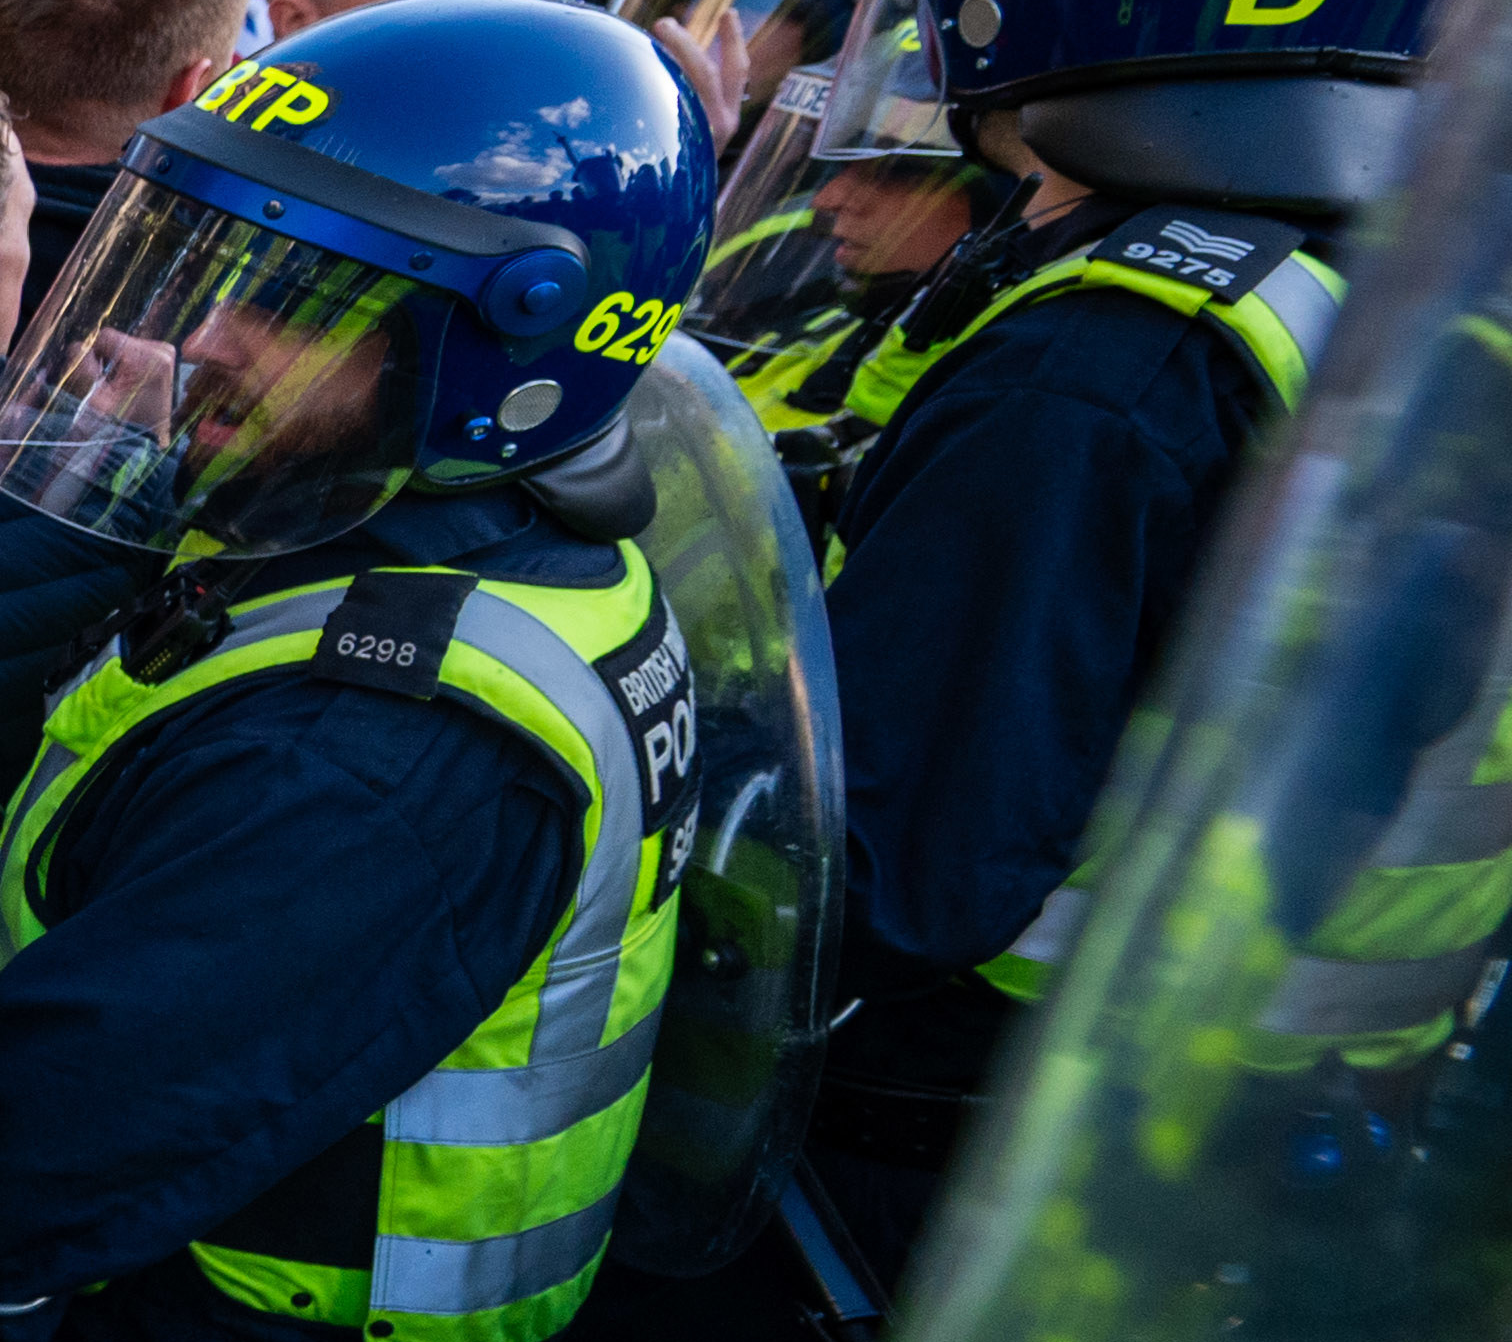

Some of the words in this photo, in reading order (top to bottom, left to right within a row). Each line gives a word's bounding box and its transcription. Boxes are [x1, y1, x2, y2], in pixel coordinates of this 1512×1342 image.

[195, 59, 331, 132] BTP
[1121, 241, 1236, 289] 9275
[573, 291, 686, 367] 629
[337, 631, 417, 668] 6298
